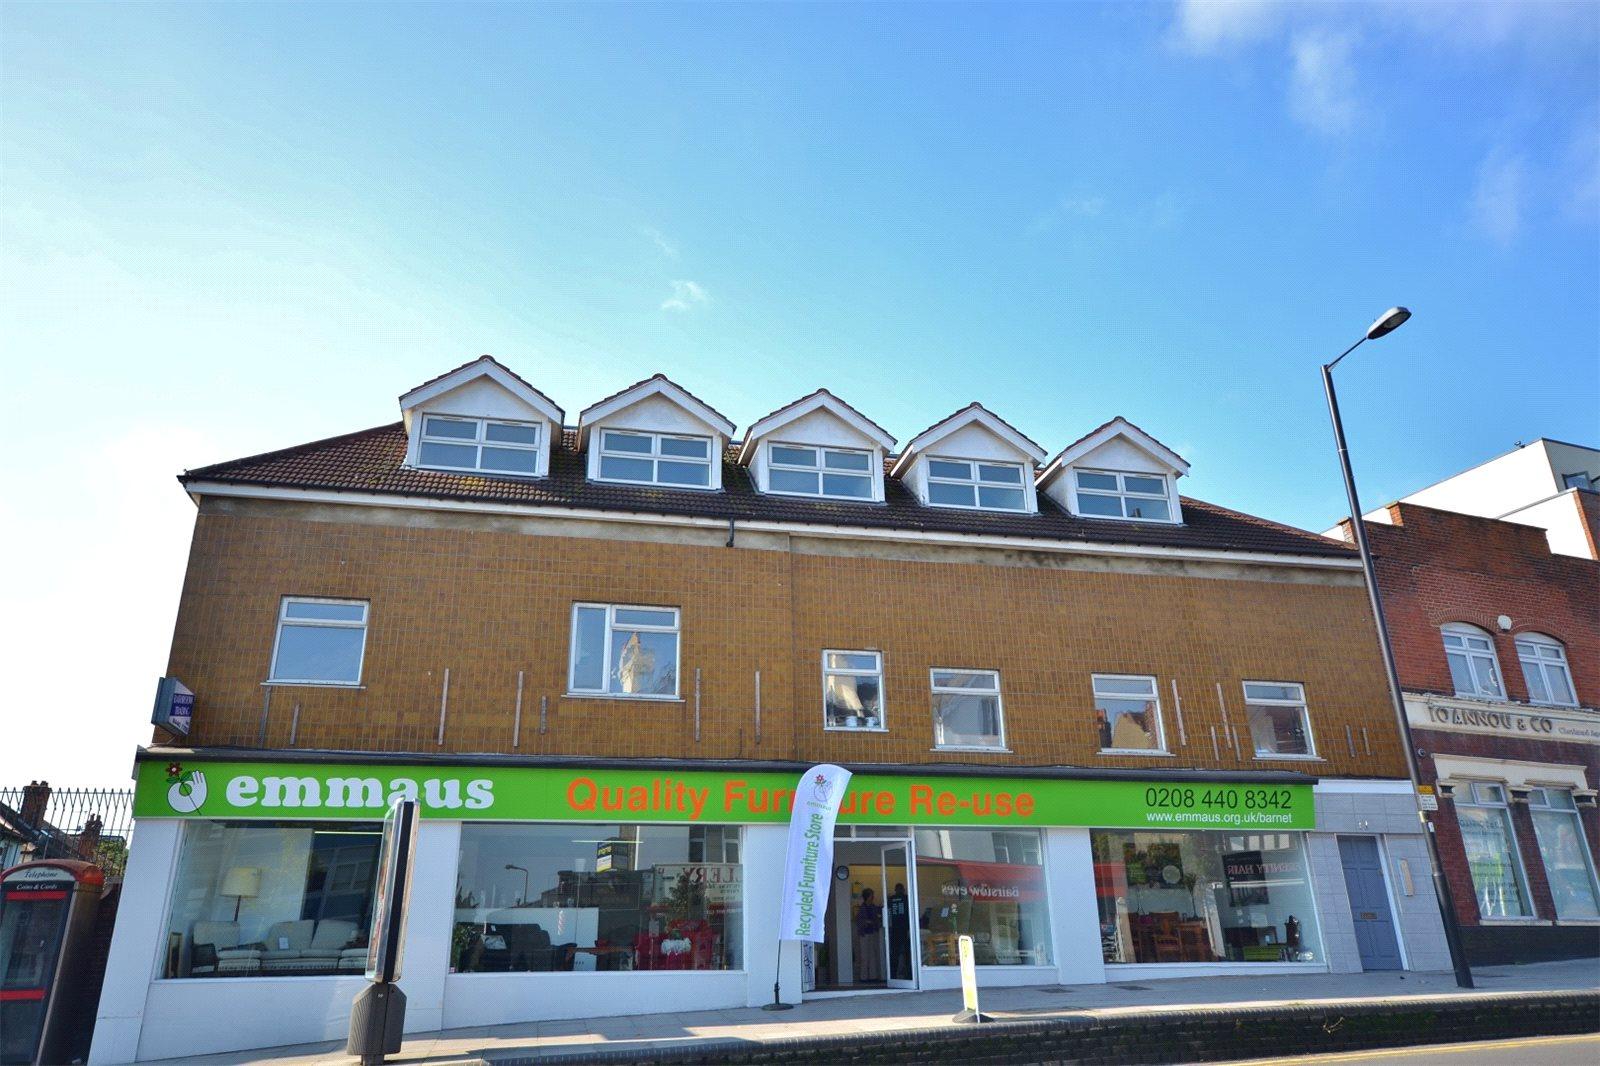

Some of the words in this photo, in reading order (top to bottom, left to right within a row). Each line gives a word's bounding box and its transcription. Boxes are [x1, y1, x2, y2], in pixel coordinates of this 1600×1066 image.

[1517, 718, 1527, 731] &
[1530, 716, 1553, 733] CO
[225, 775, 495, 809] emmaus
[567, 777, 709, 821] Quality
[723, 780, 896, 816] Furure
[910, 784, 1035, 817] Re-use
[1145, 787, 1195, 808] 0208
[1201, 790, 1238, 809] 440
[1244, 790, 1292, 809] 8342
[804, 813, 824, 841] Store
[1146, 812, 1293, 825] www.emmaus.org.uk/barnet
[798, 843, 819, 889] Furniture
[795, 889, 816, 937] Recycled
